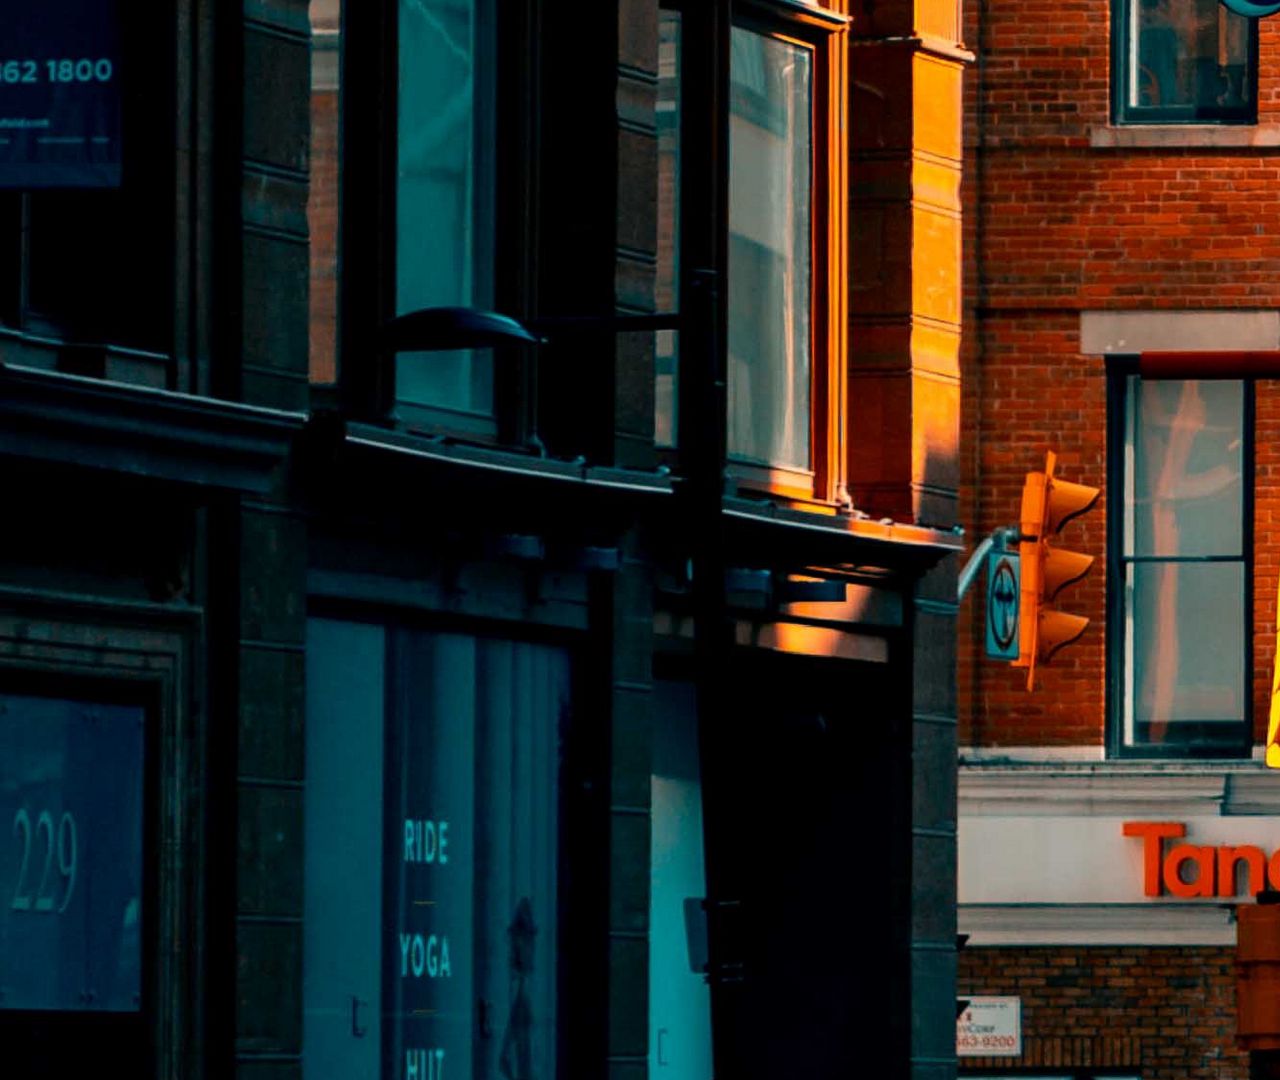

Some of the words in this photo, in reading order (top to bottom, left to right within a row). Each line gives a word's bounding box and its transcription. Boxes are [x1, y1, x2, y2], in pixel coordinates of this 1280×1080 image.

[0, 61, 37, 83] 62
[46, 58, 113, 82] 1800
[12, 808, 77, 914] 229
[403, 819, 450, 864] RIDE
[399, 932, 451, 978] YOGA
